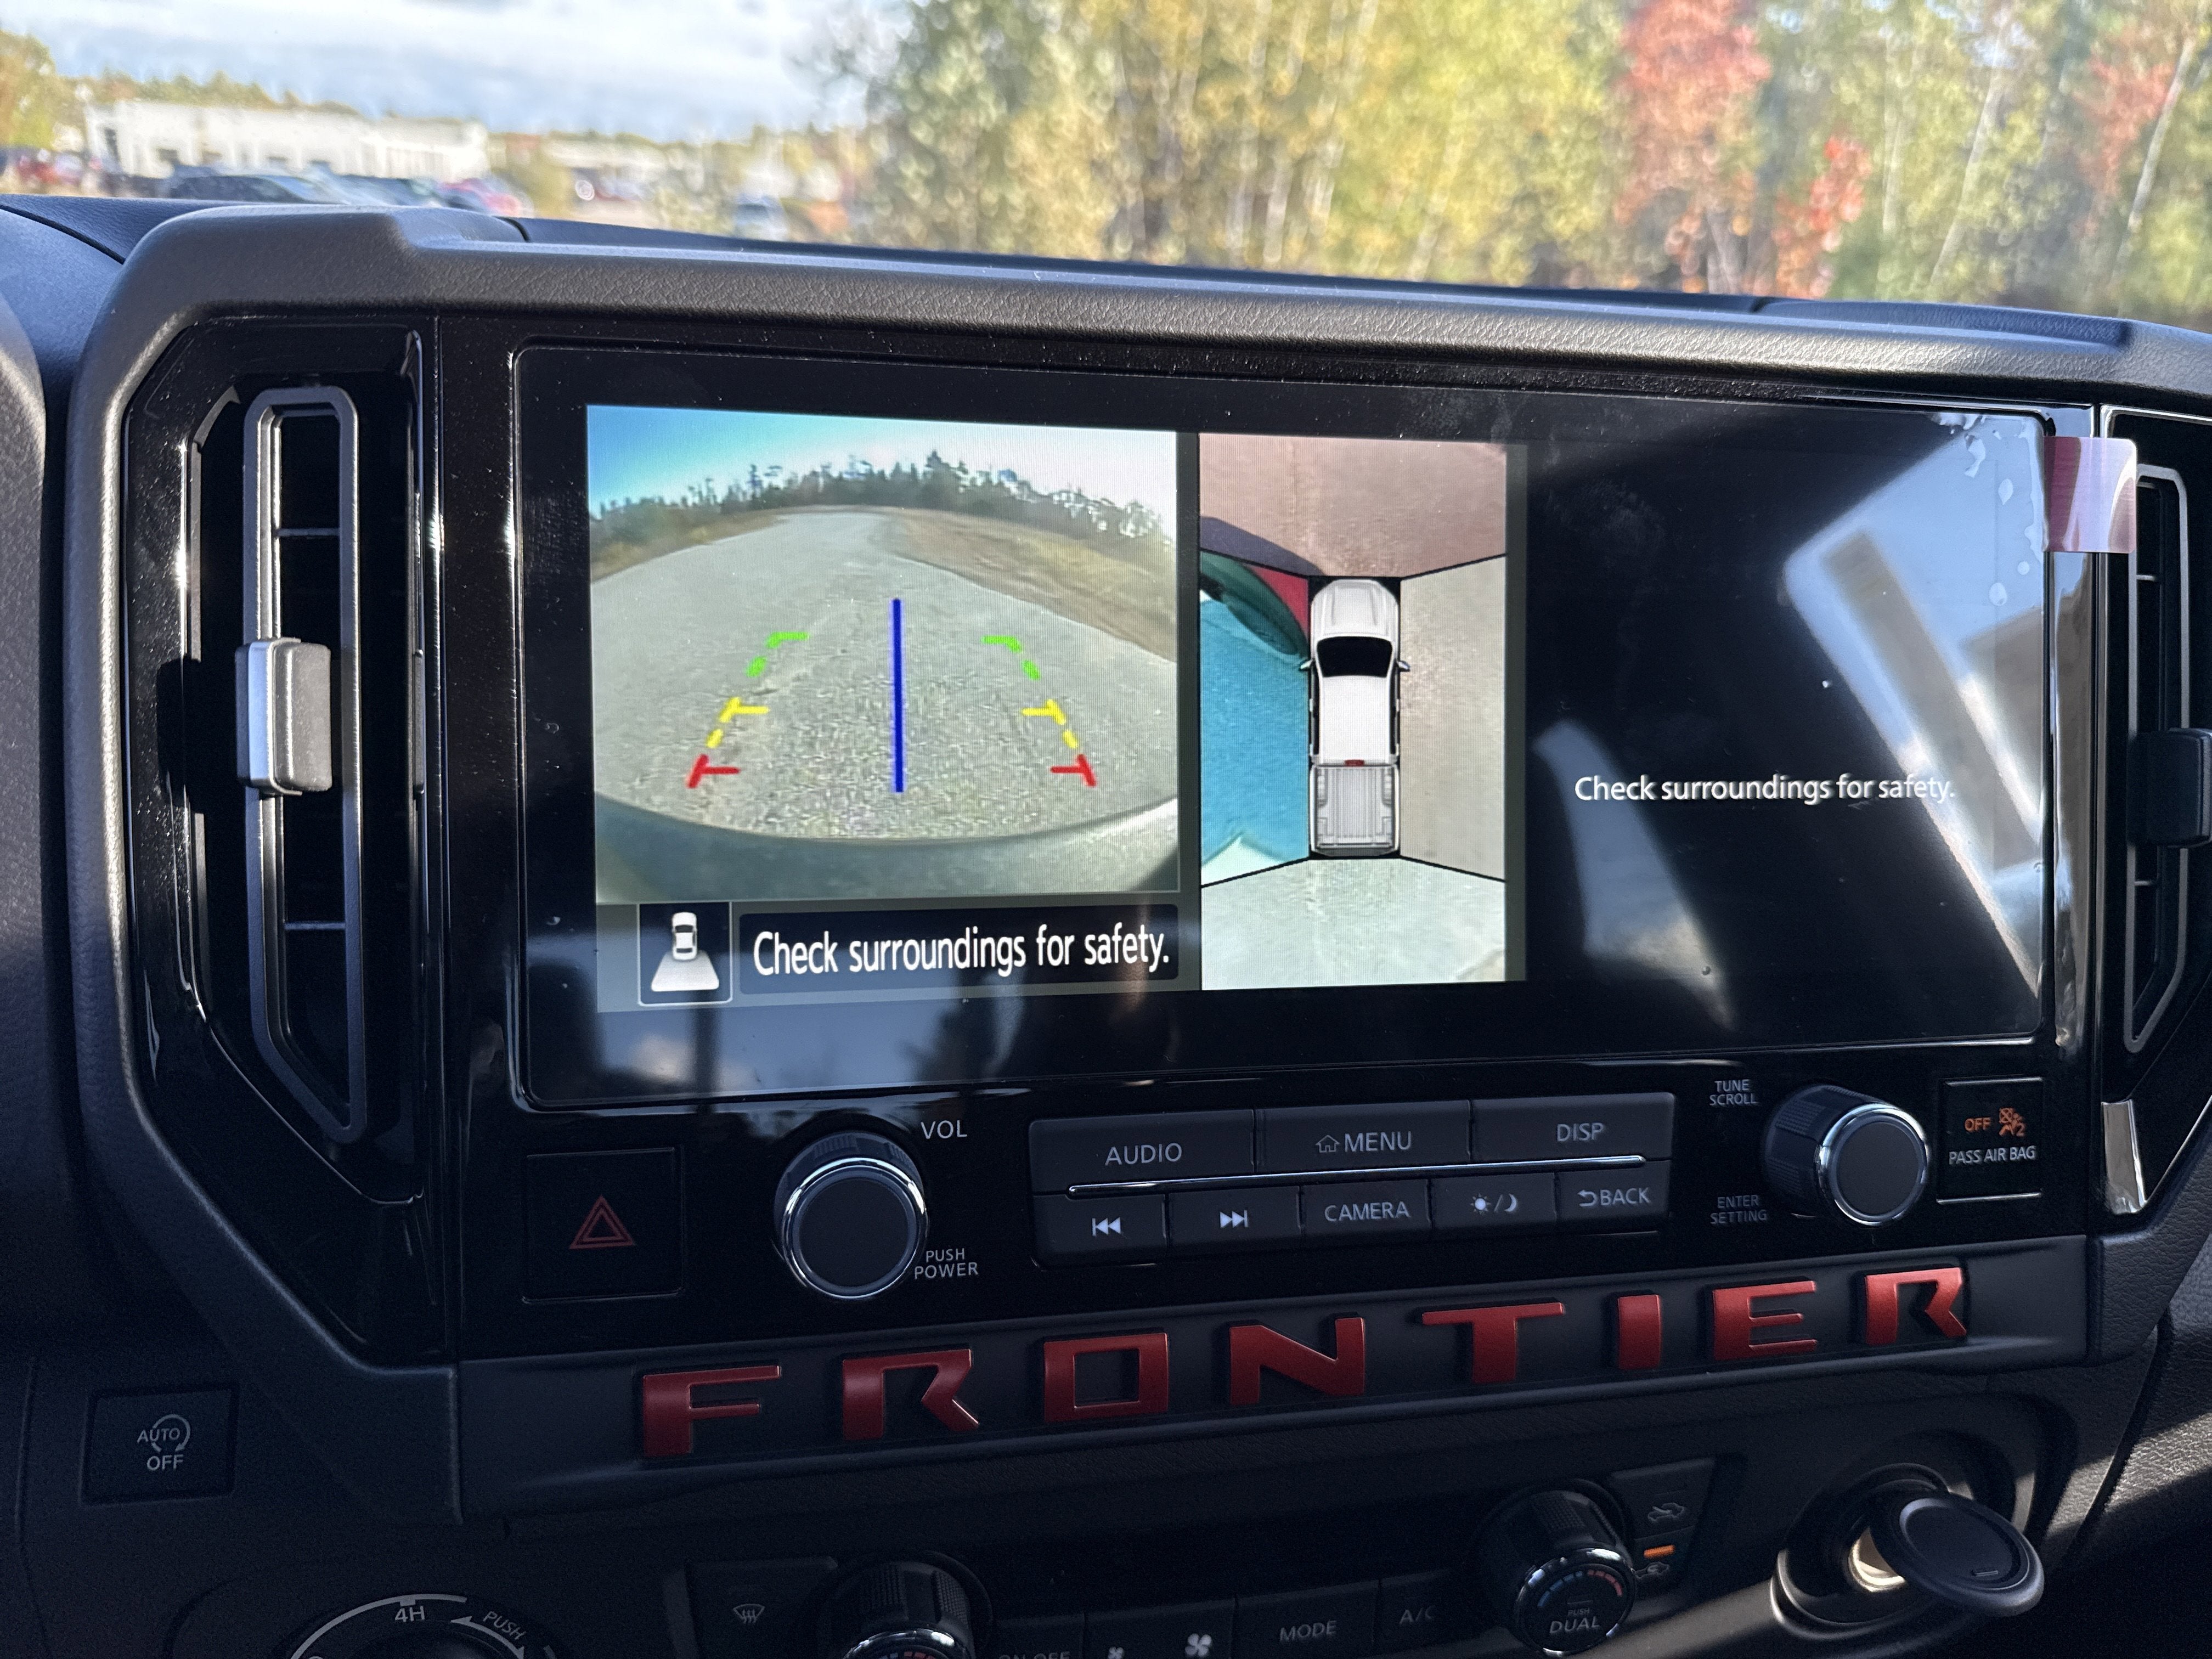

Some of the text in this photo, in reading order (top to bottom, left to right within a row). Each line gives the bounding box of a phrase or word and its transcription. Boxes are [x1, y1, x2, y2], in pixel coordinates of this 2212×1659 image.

[1574, 772, 1956, 806] Check surroundings for safety.
[752, 921, 1170, 978] Check surroundings for safety.
[1714, 1079, 1751, 1092] TUNE
[1709, 1093, 1758, 1107] SCROLL
[920, 1120, 967, 1139] VOL
[1556, 1121, 1606, 1143] DISP
[1964, 1117, 1991, 1133] OFF
[1344, 1130, 1413, 1153] MENU
[1104, 1142, 1183, 1166] AUDIO
[1949, 1145, 2036, 1165] PASS AIR BAG
[1600, 1187, 1651, 1207] BACK
[1717, 1194, 1759, 1209] ENTER
[1323, 1200, 1411, 1223] CAMERA
[1709, 1209, 1768, 1225] SETTING
[925, 1248, 966, 1263] PUSH
[914, 1262, 978, 1279] POWER
[643, 1267, 1967, 1456] FRONTIER
[137, 1426, 181, 1444] AUTO
[146, 1453, 184, 1472] OFF
[394, 1605, 426, 1624] 4H
[483, 1611, 526, 1640] PUSH
[1279, 1620, 1337, 1643] MODE
[1548, 1615, 1601, 1635] DUAL
